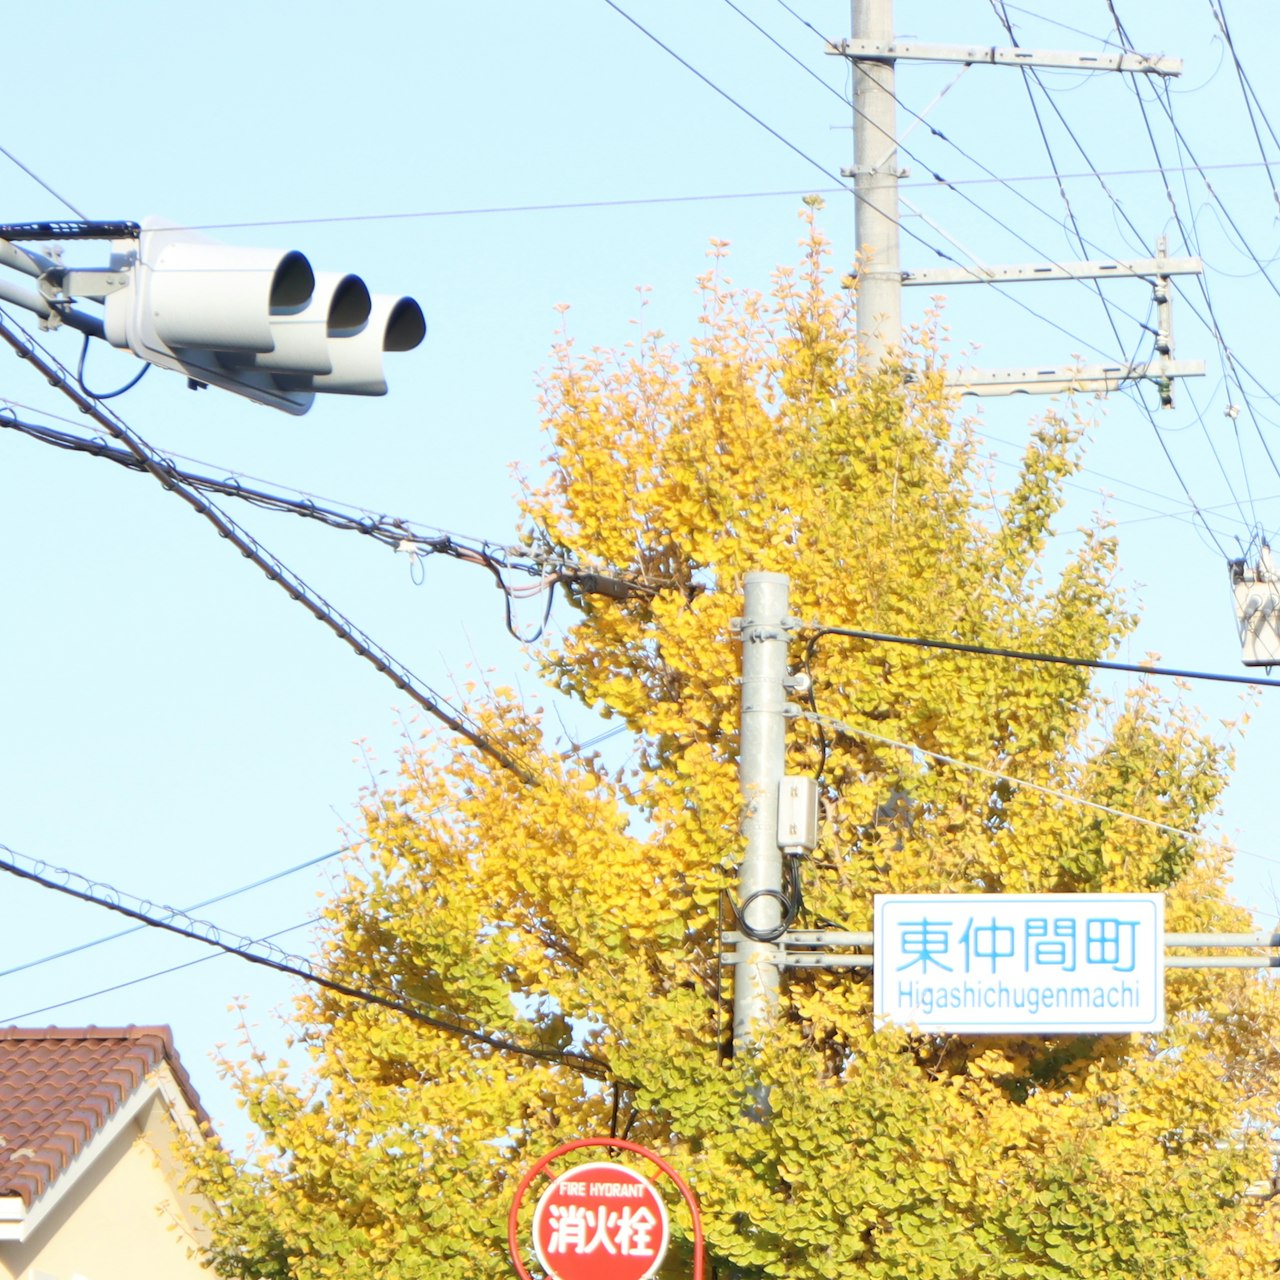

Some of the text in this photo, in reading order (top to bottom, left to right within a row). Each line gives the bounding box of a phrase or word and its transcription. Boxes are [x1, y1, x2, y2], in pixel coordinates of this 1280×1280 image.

[896, 916, 1141, 974] 東仲間町
[897, 980, 1140, 1014] Higashichugenmachi
[559, 1181, 646, 1198] FIRE HYDRANT
[547, 1204, 656, 1255] 消火栓
